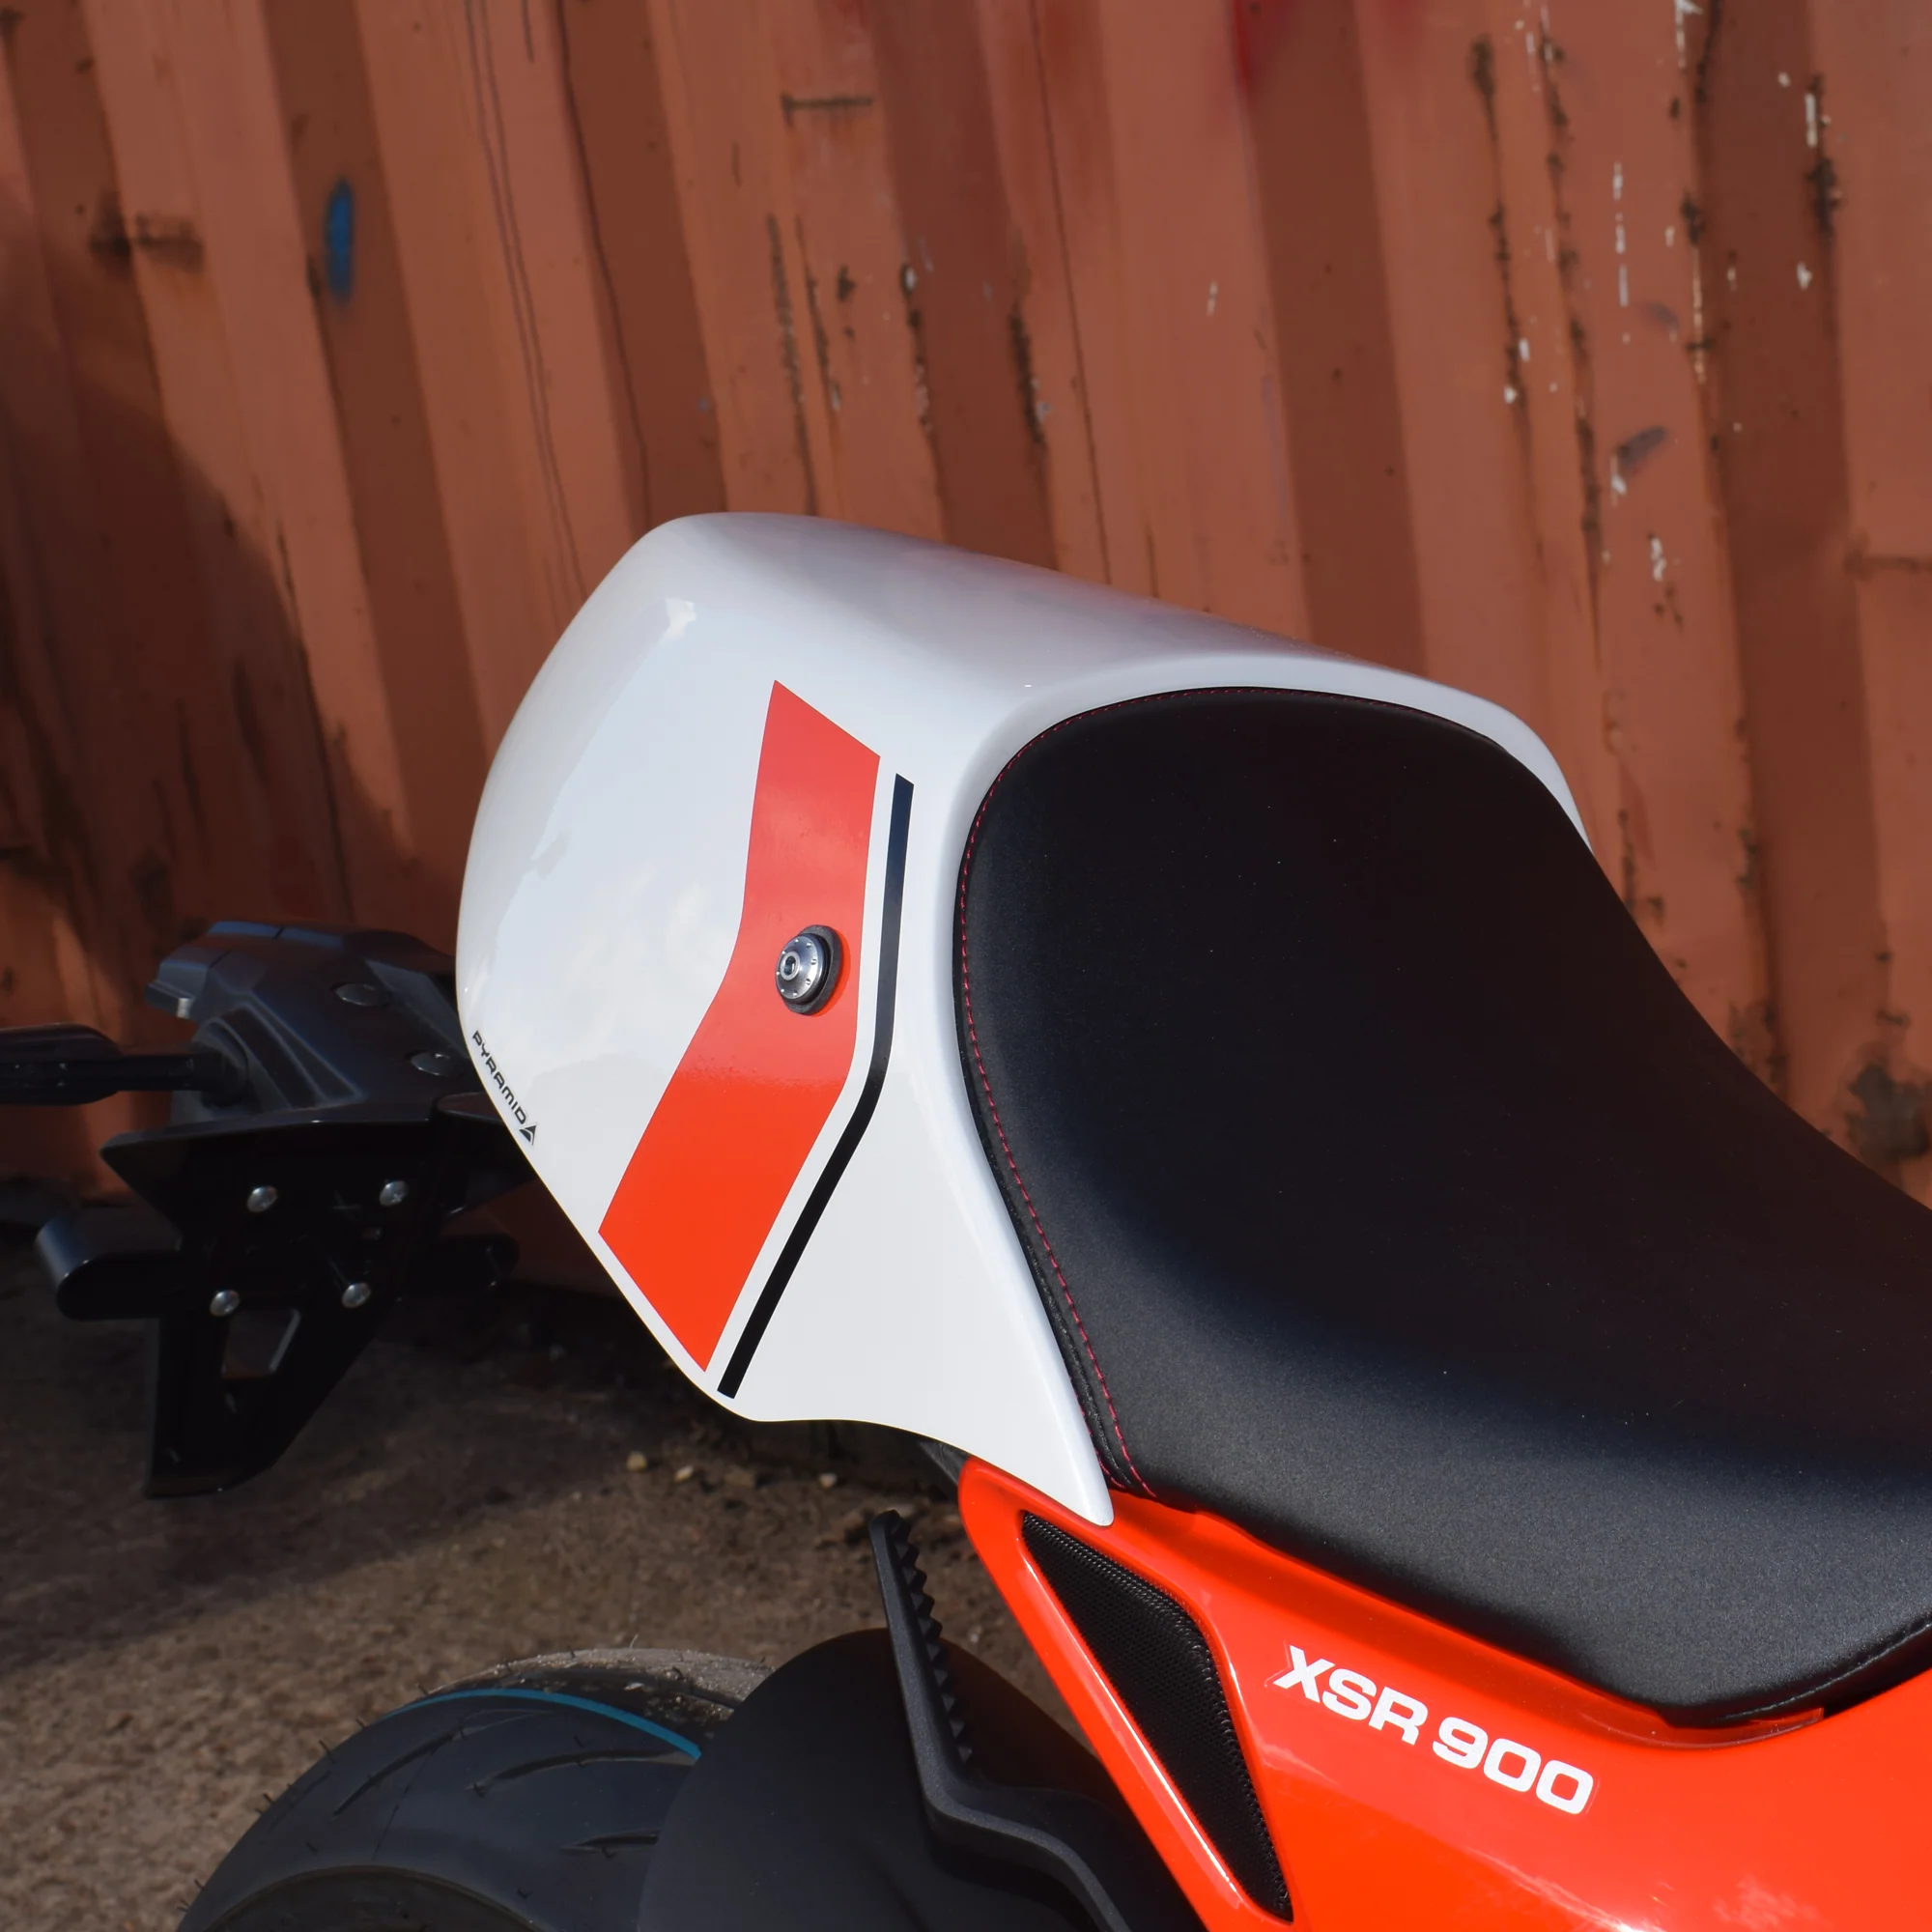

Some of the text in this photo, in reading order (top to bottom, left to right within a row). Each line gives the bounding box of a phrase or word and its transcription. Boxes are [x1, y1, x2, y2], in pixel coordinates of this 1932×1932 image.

[472, 1031, 527, 1125] PYRAMID
[1273, 1645, 1594, 1815] XSR 900
